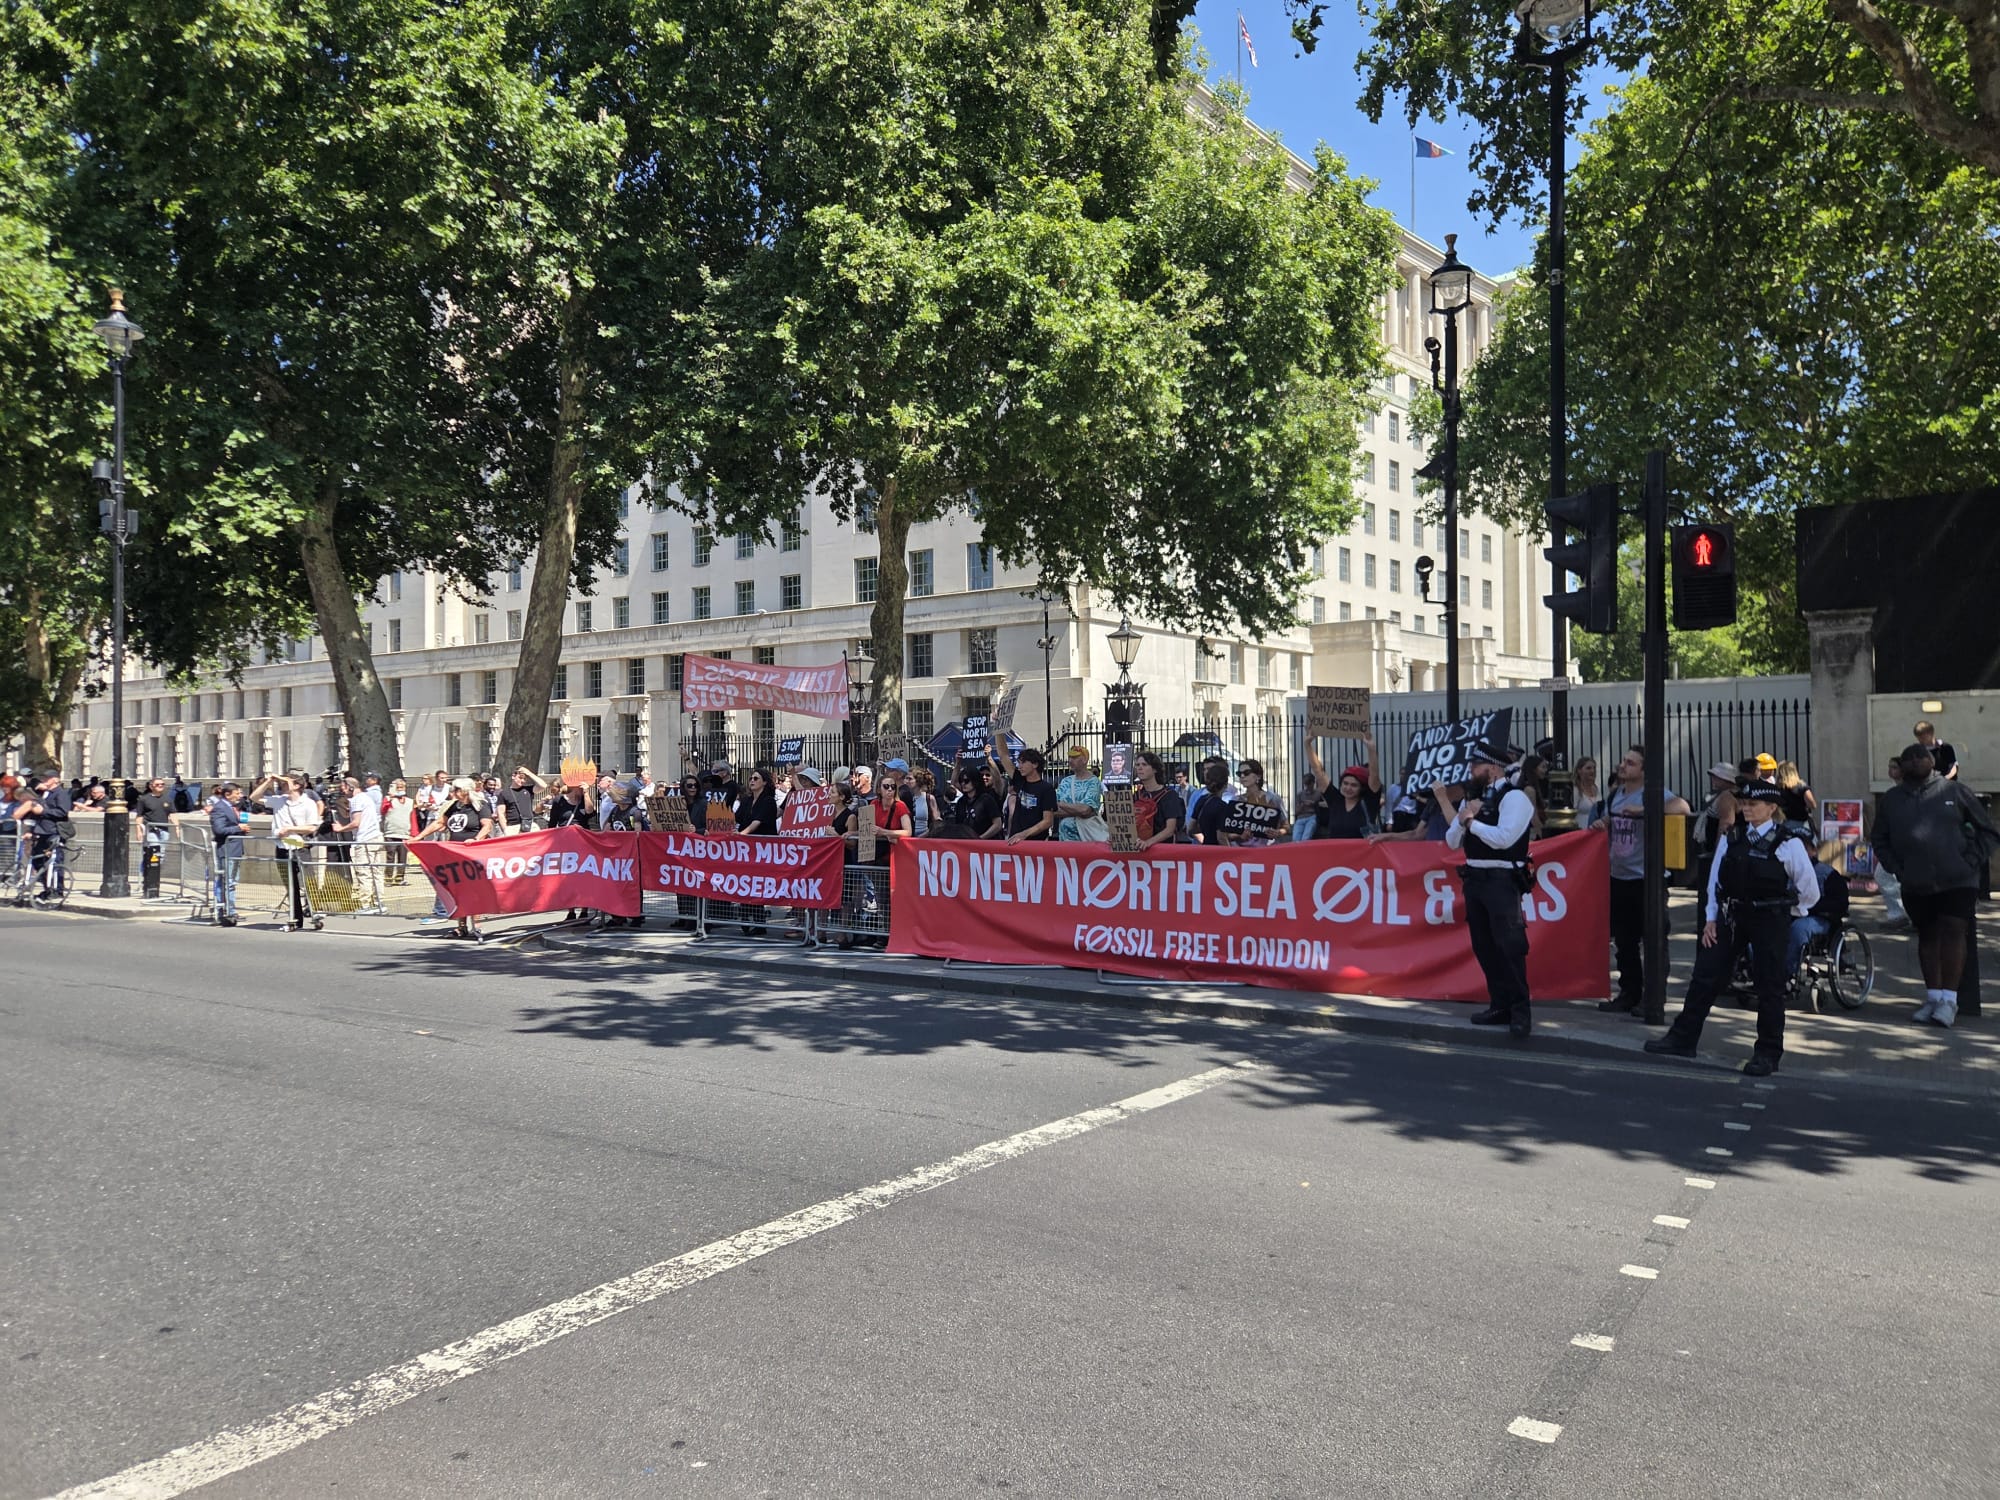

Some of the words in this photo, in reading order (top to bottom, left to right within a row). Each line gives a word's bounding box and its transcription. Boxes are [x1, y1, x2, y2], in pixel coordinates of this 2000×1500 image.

[783, 669, 836, 692] MUST
[685, 684, 739, 708] STOP
[744, 684, 836, 716] ROSEBANK
[1335, 688, 1369, 702] DEATHS
[1312, 701, 1331, 715] WHY
[967, 716, 987, 728] STOP
[1308, 715, 1324, 729] YOU
[1327, 718, 1368, 732] LISTENING
[1456, 713, 1496, 740] SAY
[963, 727, 988, 739] NORTH
[781, 741, 800, 752] STOP
[967, 739, 984, 749] SEA
[962, 751, 986, 759] DRILLIN
[1415, 744, 1455, 772] NO
[1406, 762, 1473, 794] ROSEBA
[705, 790, 727, 802] SAY
[819, 786, 832, 800] SA
[793, 803, 819, 825] NO
[822, 803, 835, 816] TO
[1109, 804, 1132, 814] DEAD
[1233, 802, 1278, 821] STOP
[1118, 815, 1135, 824] FIRST
[780, 826, 826, 839] ROSEBAN
[1115, 825, 1128, 833] TWO
[1110, 833, 1132, 843] HEAT
[667, 835, 750, 862] LABOUR
[755, 842, 812, 866] MUST
[435, 860, 484, 885] STOP
[486, 852, 634, 881] ROSEBANK
[659, 864, 705, 888] STOP
[710, 873, 823, 900] ROSEBANK
[918, 850, 960, 898] NO
[969, 852, 1044, 904] NEW
[1214, 861, 1297, 921] SEA
[1423, 870, 1456, 925] &
[1163, 931, 1220, 963] FREE
[1227, 935, 1330, 971] LONDON
